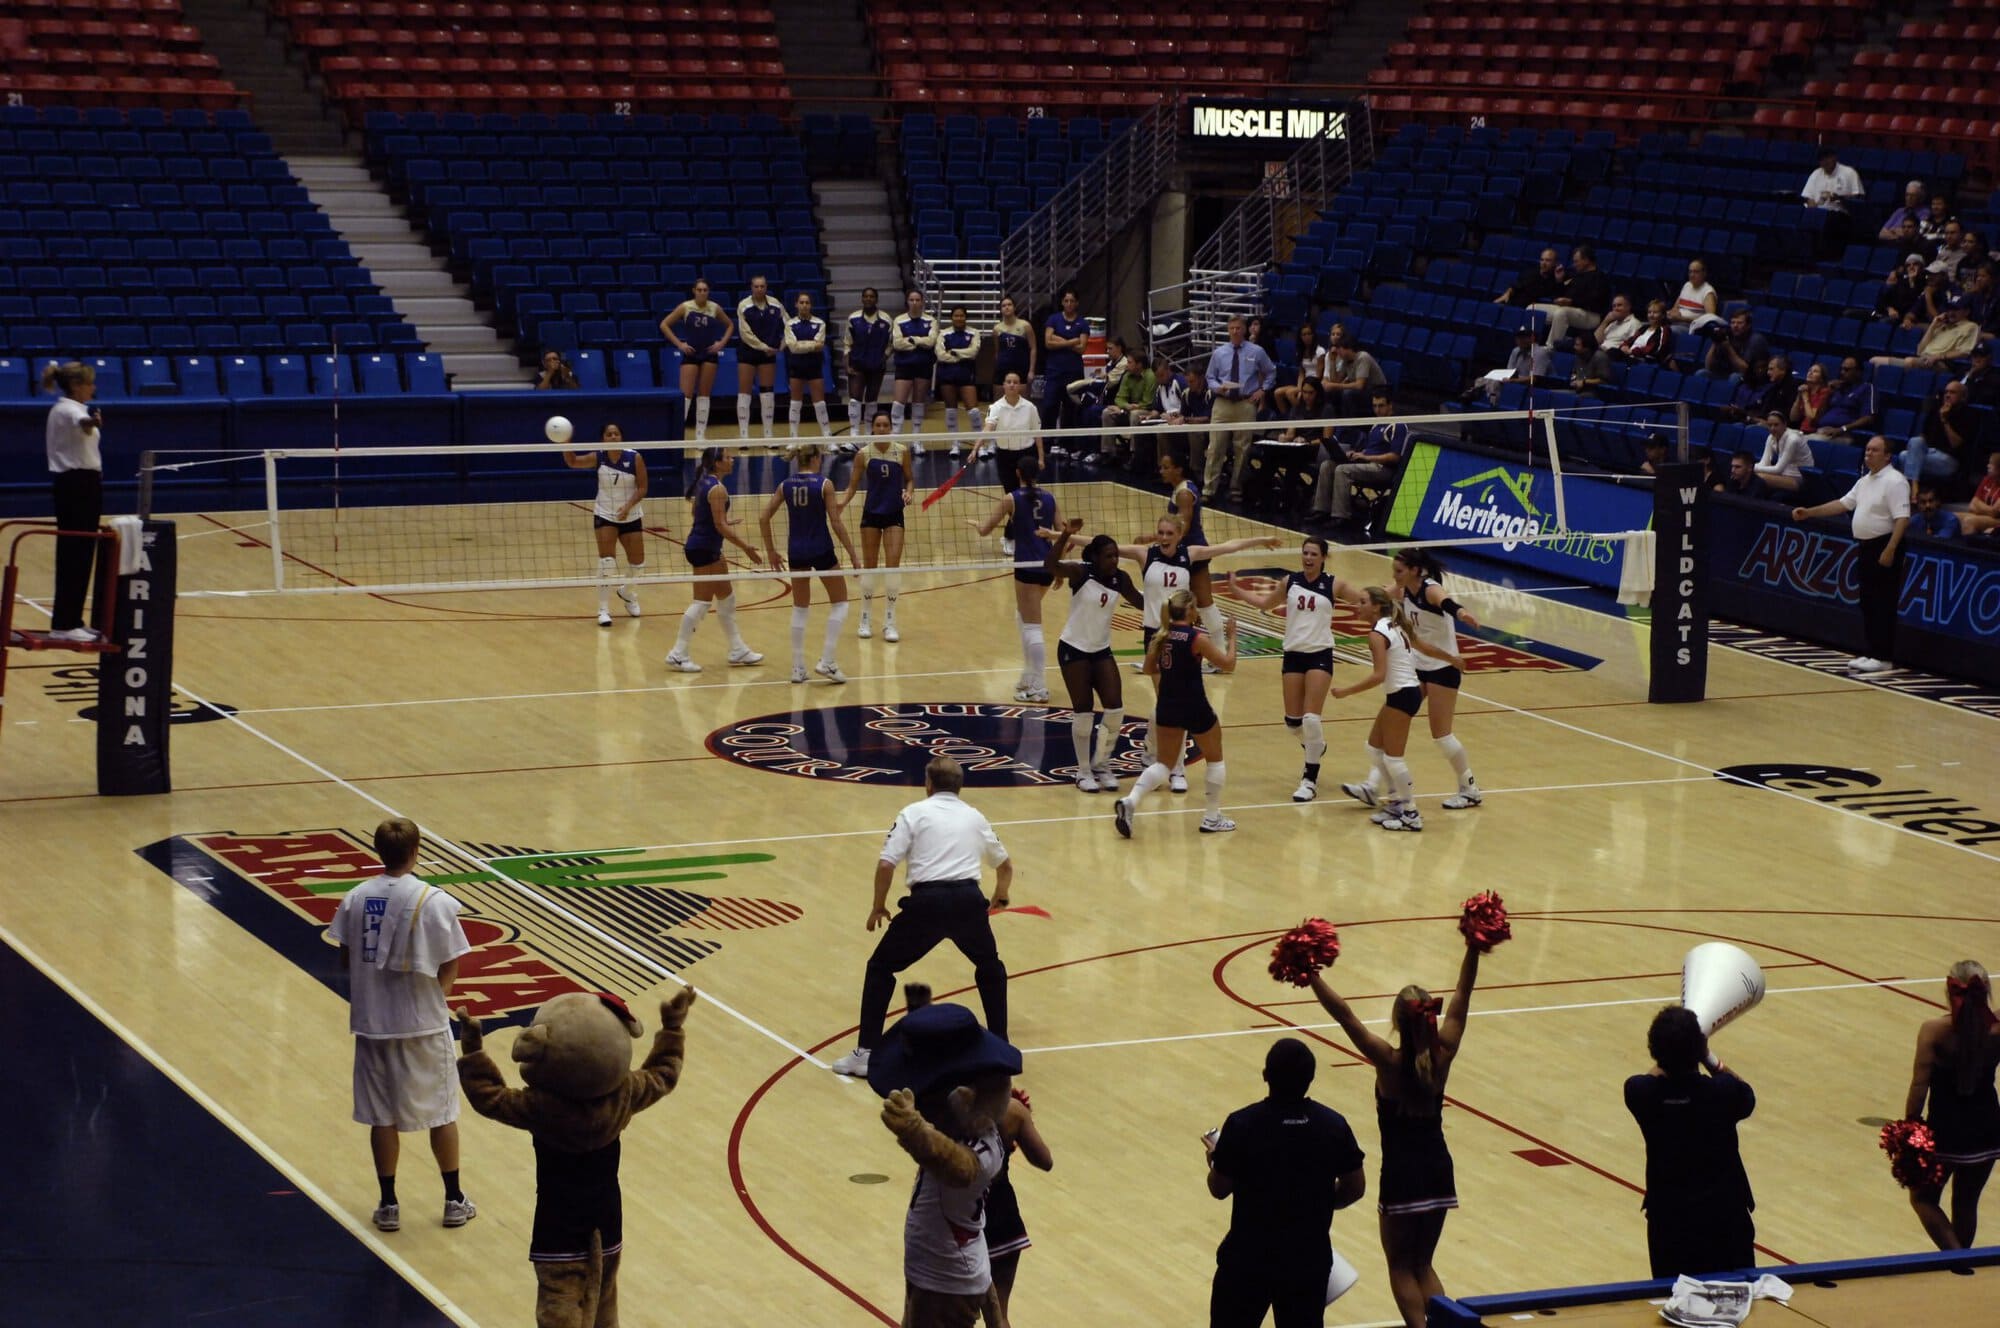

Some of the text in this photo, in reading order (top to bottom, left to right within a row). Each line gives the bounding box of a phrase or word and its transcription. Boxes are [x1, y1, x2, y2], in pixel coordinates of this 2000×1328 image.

[7, 92, 23, 107] 21
[615, 102, 631, 116] 22
[1027, 106, 1044, 119] 23
[1193, 106, 1347, 139] MUSCLE MILK
[1471, 116, 1485, 129] 24
[611, 473, 620, 485] 7
[880, 463, 890, 478] 9
[791, 486, 808, 507] 10
[1032, 499, 1044, 520] 2
[1433, 491, 1621, 564] Meritage Homes
[1163, 572, 1178, 587] 12
[1676, 487, 1698, 666] WILDCATS
[1738, 522, 1941, 623] ARIZOA
[1099, 593, 1108, 607] 9
[1296, 595, 1316, 612] 34
[123, 550, 153, 745] ARIZONA
[721, 722, 905, 782] COURT
